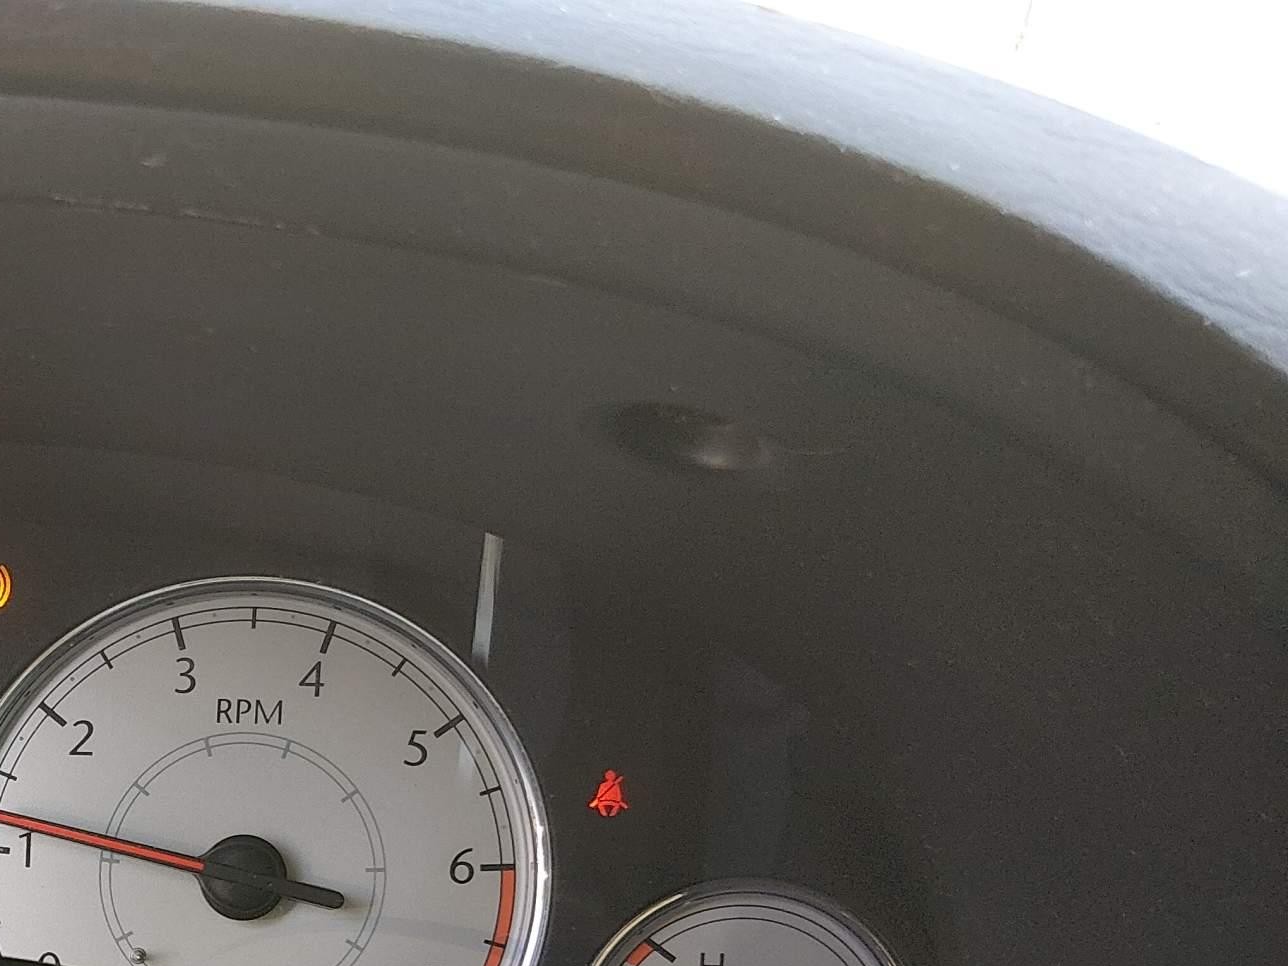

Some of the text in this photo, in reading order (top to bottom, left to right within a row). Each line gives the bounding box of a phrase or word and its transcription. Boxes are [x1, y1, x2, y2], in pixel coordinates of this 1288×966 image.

[174, 657, 196, 694] 3
[298, 661, 325, 698] 4
[216, 698, 283, 726] RPM
[68, 720, 94, 756] 2
[403, 730, 429, 767] 5
[18, 832, 33, 868] 1
[449, 848, 475, 885] 6
